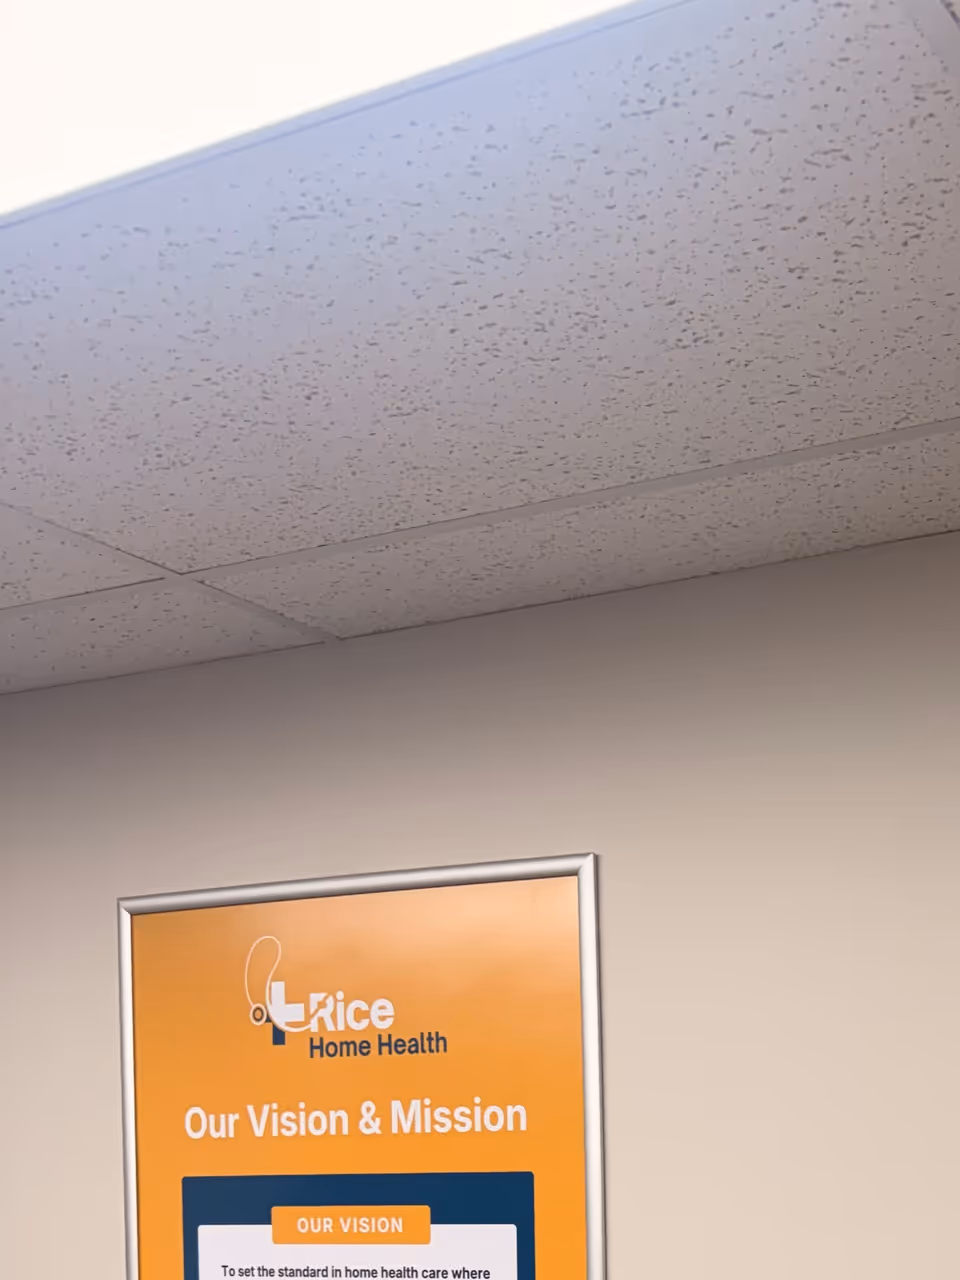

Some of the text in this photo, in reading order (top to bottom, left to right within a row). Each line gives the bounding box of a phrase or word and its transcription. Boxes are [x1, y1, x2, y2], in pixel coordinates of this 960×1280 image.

[308, 991, 394, 1031] Rice
[309, 1031, 447, 1058] Home Health
[184, 1098, 527, 1139] Our Vision & Mission
[296, 1217, 402, 1233] OUR VISION
[221, 1265, 490, 1279] To set the standard in home health care where
